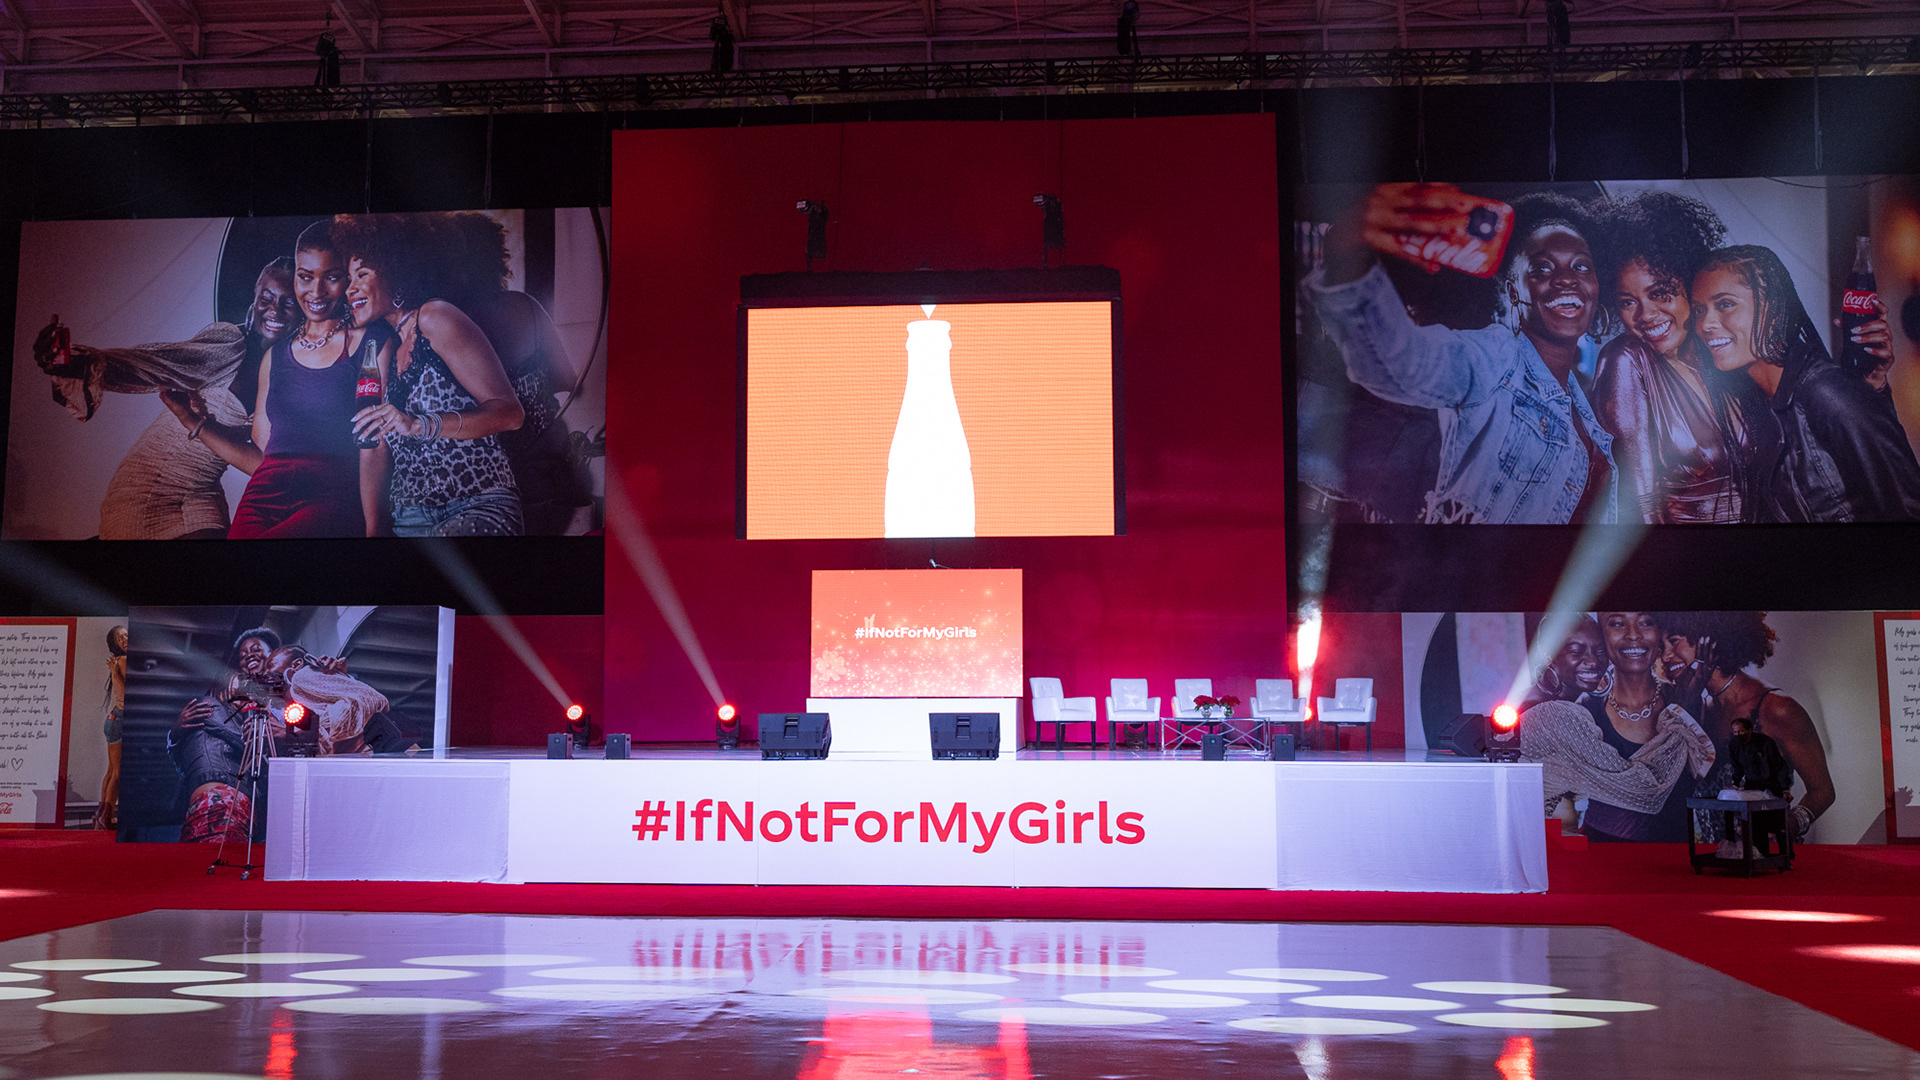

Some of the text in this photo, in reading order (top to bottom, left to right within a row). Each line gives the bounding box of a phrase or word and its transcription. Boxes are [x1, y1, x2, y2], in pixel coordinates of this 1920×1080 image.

[1843, 291, 1879, 309] Coca-C
[854, 626, 977, 640] #IfNotForMyGirls
[631, 798, 1146, 854] #IfNotForMyGirls
